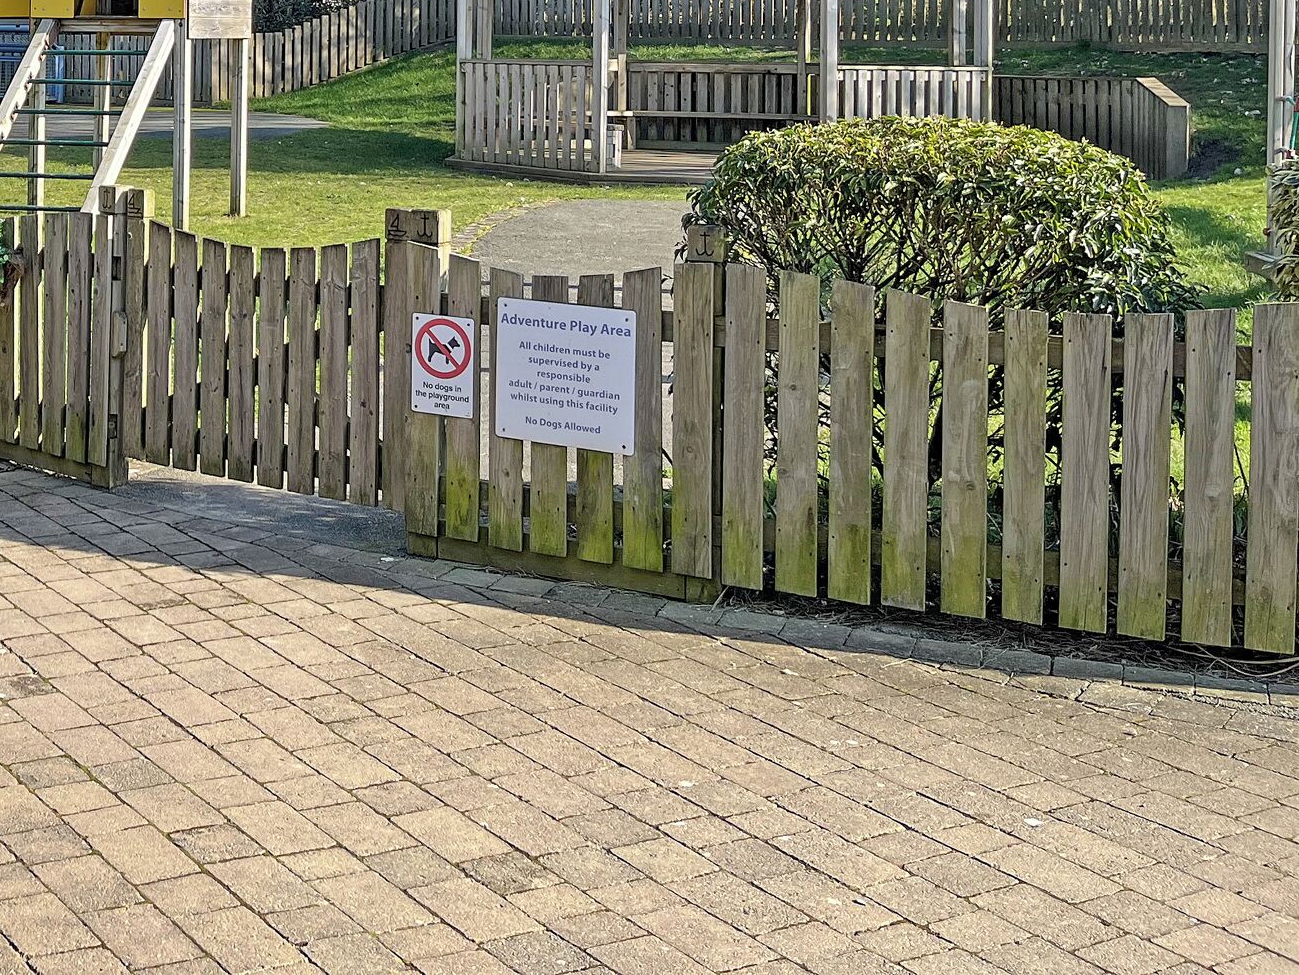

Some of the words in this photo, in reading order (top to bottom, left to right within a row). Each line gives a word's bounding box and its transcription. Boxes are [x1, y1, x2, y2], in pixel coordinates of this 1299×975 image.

[501, 313, 566, 330] Adventure
[570, 320, 597, 336] Play
[601, 324, 631, 337] Area
[519, 341, 531, 349] All
[533, 343, 570, 354] children
[573, 348, 596, 357] must
[598, 349, 610, 359] be
[528, 357, 578, 369] supervised
[581, 361, 592, 372] by
[537, 371, 590, 383] responsible
[423, 381, 433, 389] No
[435, 383, 453, 392] dogs
[509, 380, 532, 389] adult
[539, 384, 569, 394] parent
[577, 389, 620, 400] guardian
[415, 389, 427, 397] the
[428, 392, 469, 403] playground
[511, 393, 537, 402] whilst
[539, 396, 564, 408] using
[566, 400, 583, 409] this
[586, 401, 618, 415] facility
[525, 416, 537, 425] No
[540, 418, 562, 429] Dogs
[564, 422, 601, 434] Allowed
